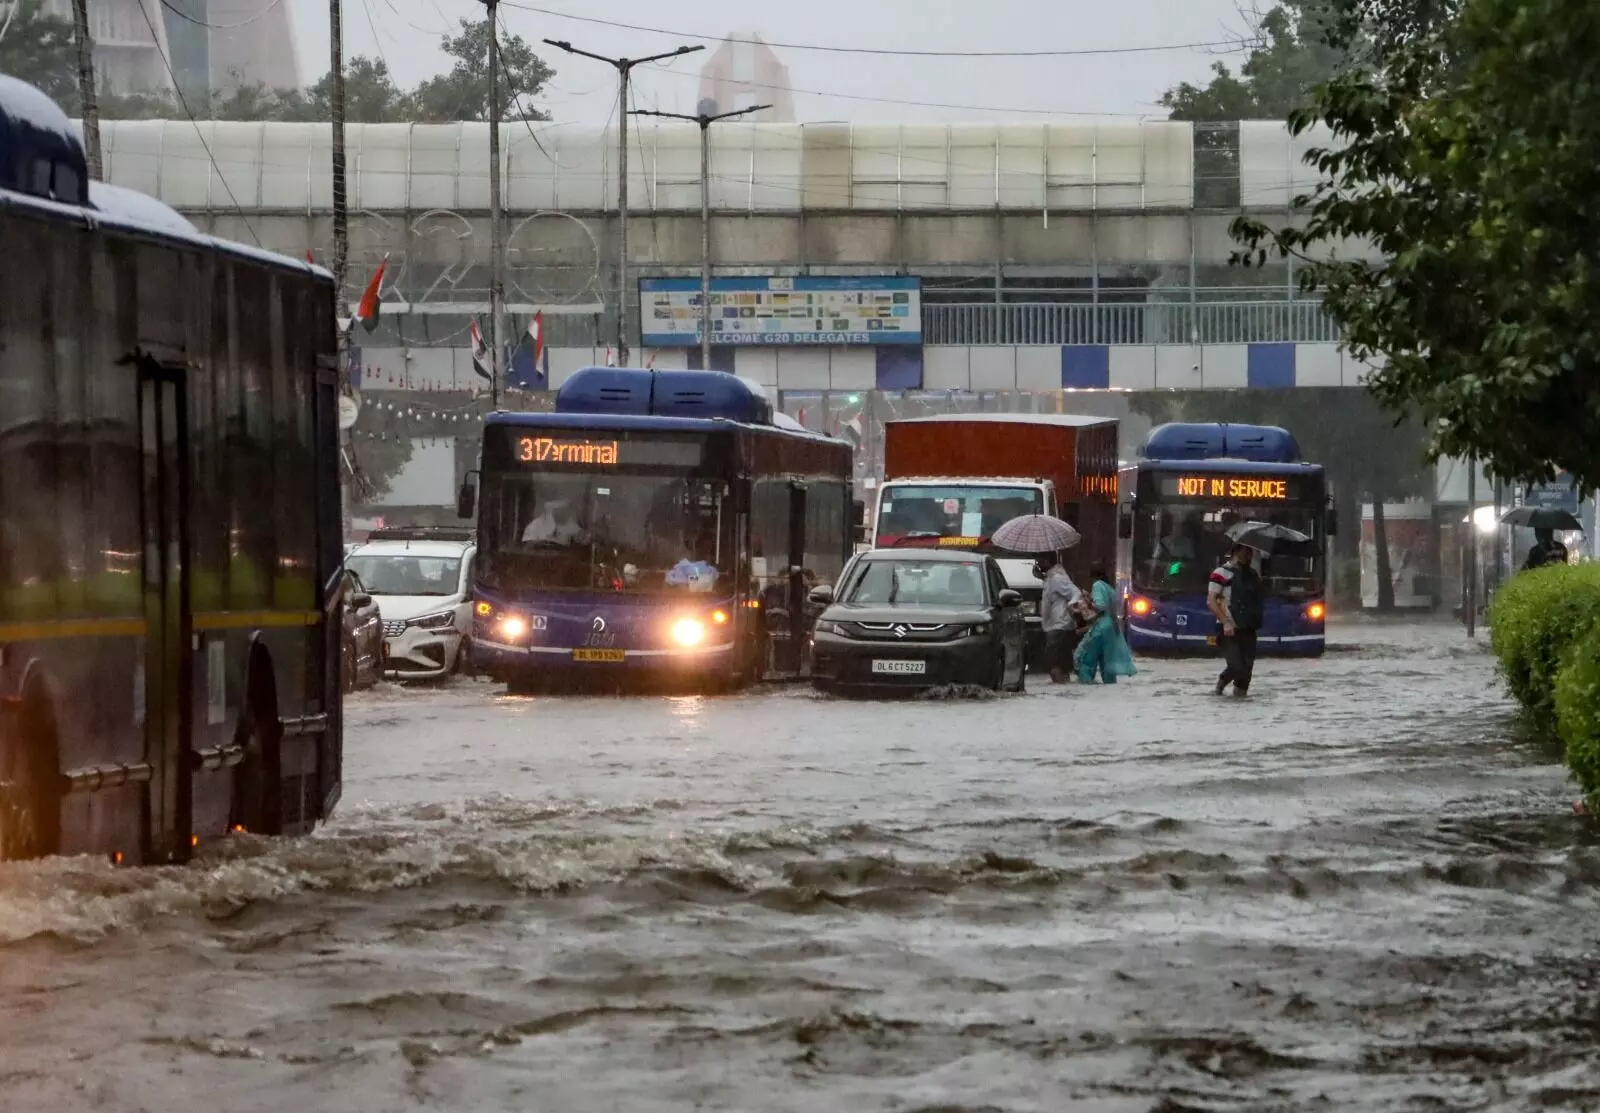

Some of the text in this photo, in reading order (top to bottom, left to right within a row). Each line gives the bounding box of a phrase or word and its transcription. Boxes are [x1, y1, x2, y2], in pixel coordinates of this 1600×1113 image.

[764, 332, 790, 344] G20
[793, 332, 870, 343] DELEGATES
[1178, 478, 1287, 498] NOT IN SERVICE
[905, 663, 924, 672] 5227
